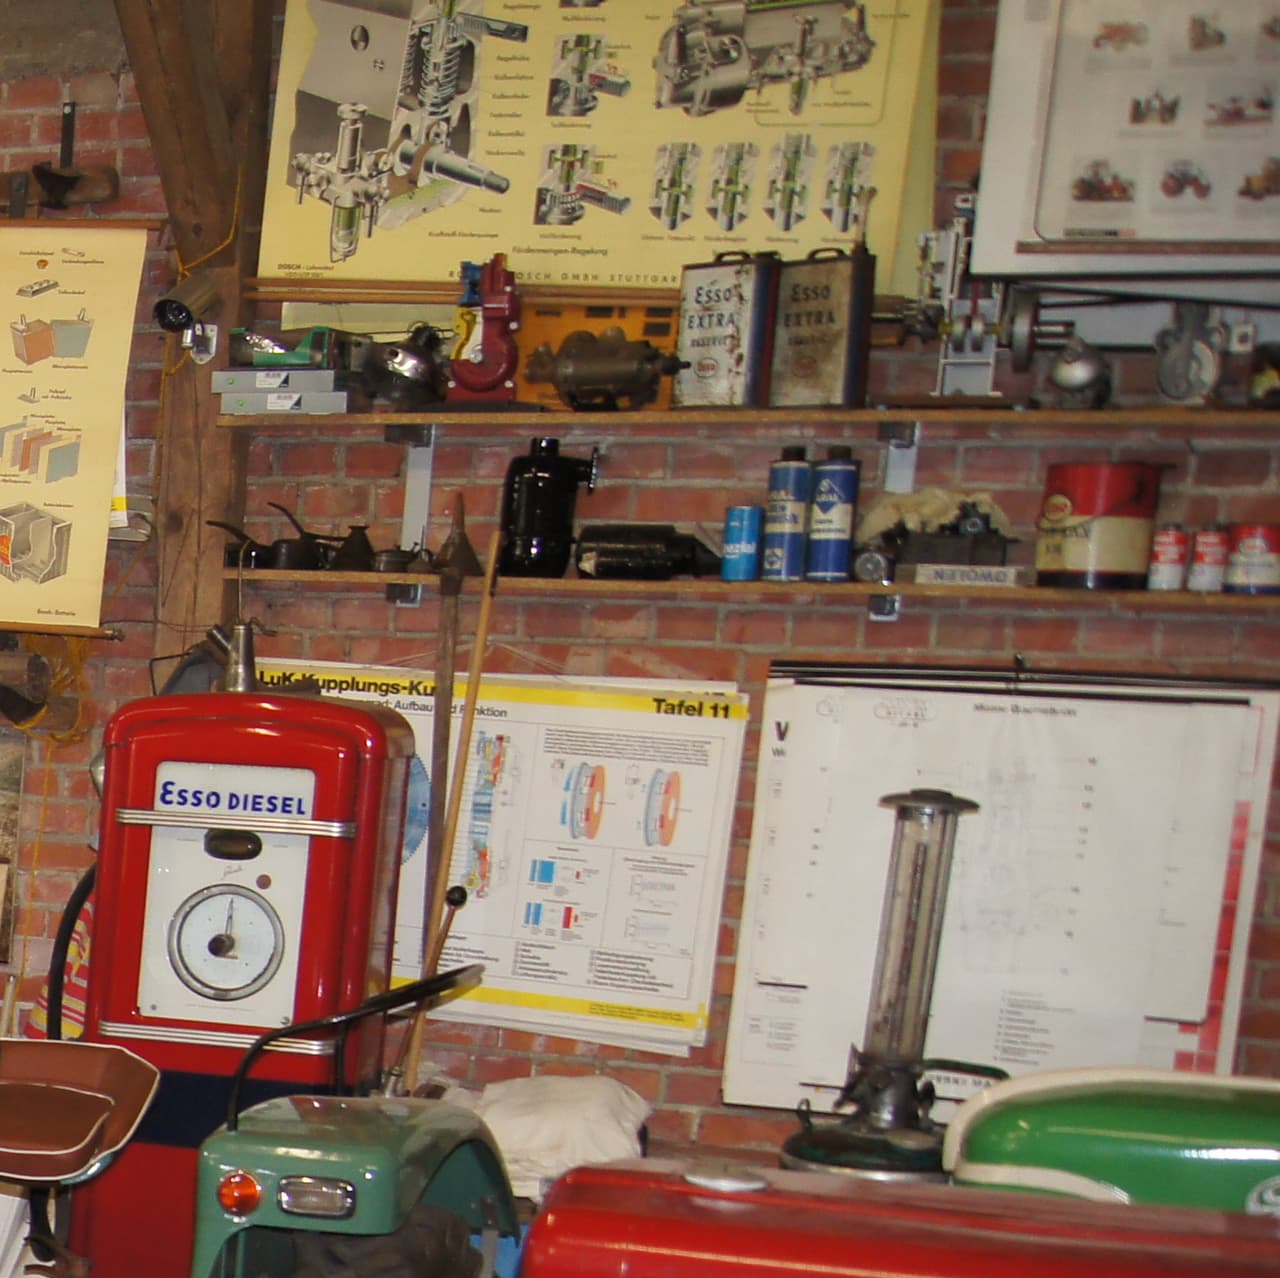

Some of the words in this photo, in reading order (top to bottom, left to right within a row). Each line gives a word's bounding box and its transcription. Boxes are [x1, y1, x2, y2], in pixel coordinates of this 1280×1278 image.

[560, 273, 599, 282] GMBH
[609, 273, 678, 283] STUTTGAR
[694, 286, 732, 304] ESSO
[687, 312, 736, 329] EXTRA
[784, 310, 836, 328] EXTRA
[259, 670, 435, 697] LuK-upplungs-Ku
[393, 700, 433, 713] Aufbau
[459, 706, 508, 719] Fnktion
[653, 697, 704, 718] Tafel
[711, 702, 730, 719] 11
[159, 780, 220, 810] ESSO
[227, 792, 307, 816] DIESEL
